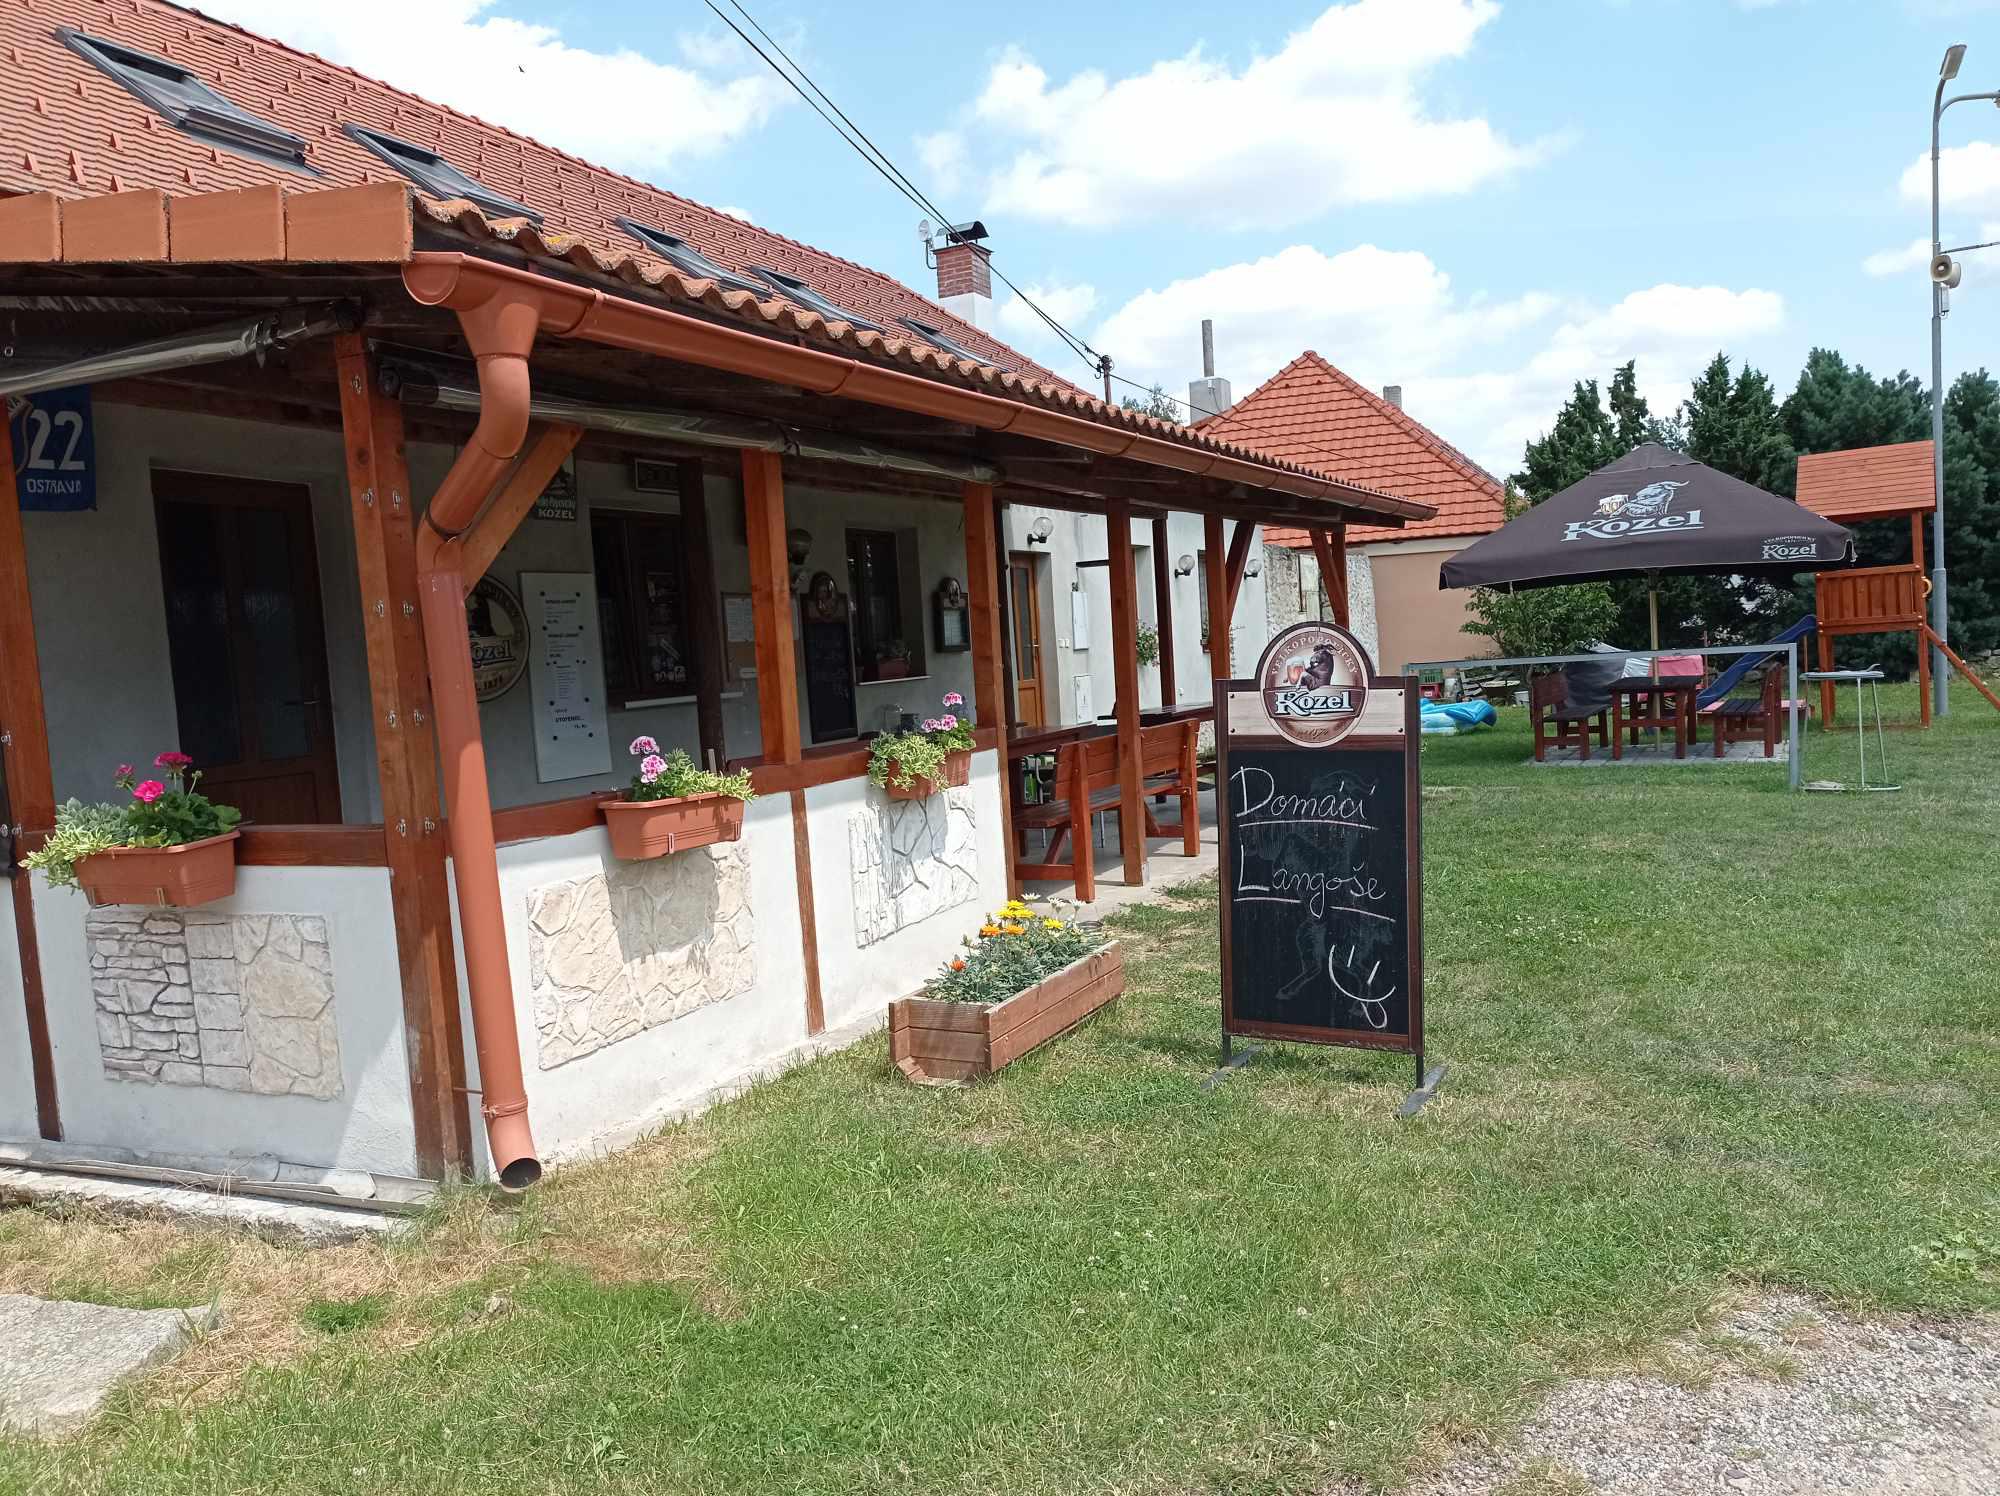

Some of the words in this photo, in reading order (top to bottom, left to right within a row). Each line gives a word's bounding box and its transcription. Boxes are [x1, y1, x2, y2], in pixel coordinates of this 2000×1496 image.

[26, 478, 82, 494] OSTRAVA
[1560, 509, 1704, 542] Kozel
[1762, 543, 1816, 560] Kozel
[1274, 690, 1354, 716] Kozel
[1230, 766, 1376, 820] Domácí
[1238, 844, 1386, 919] Langoše
